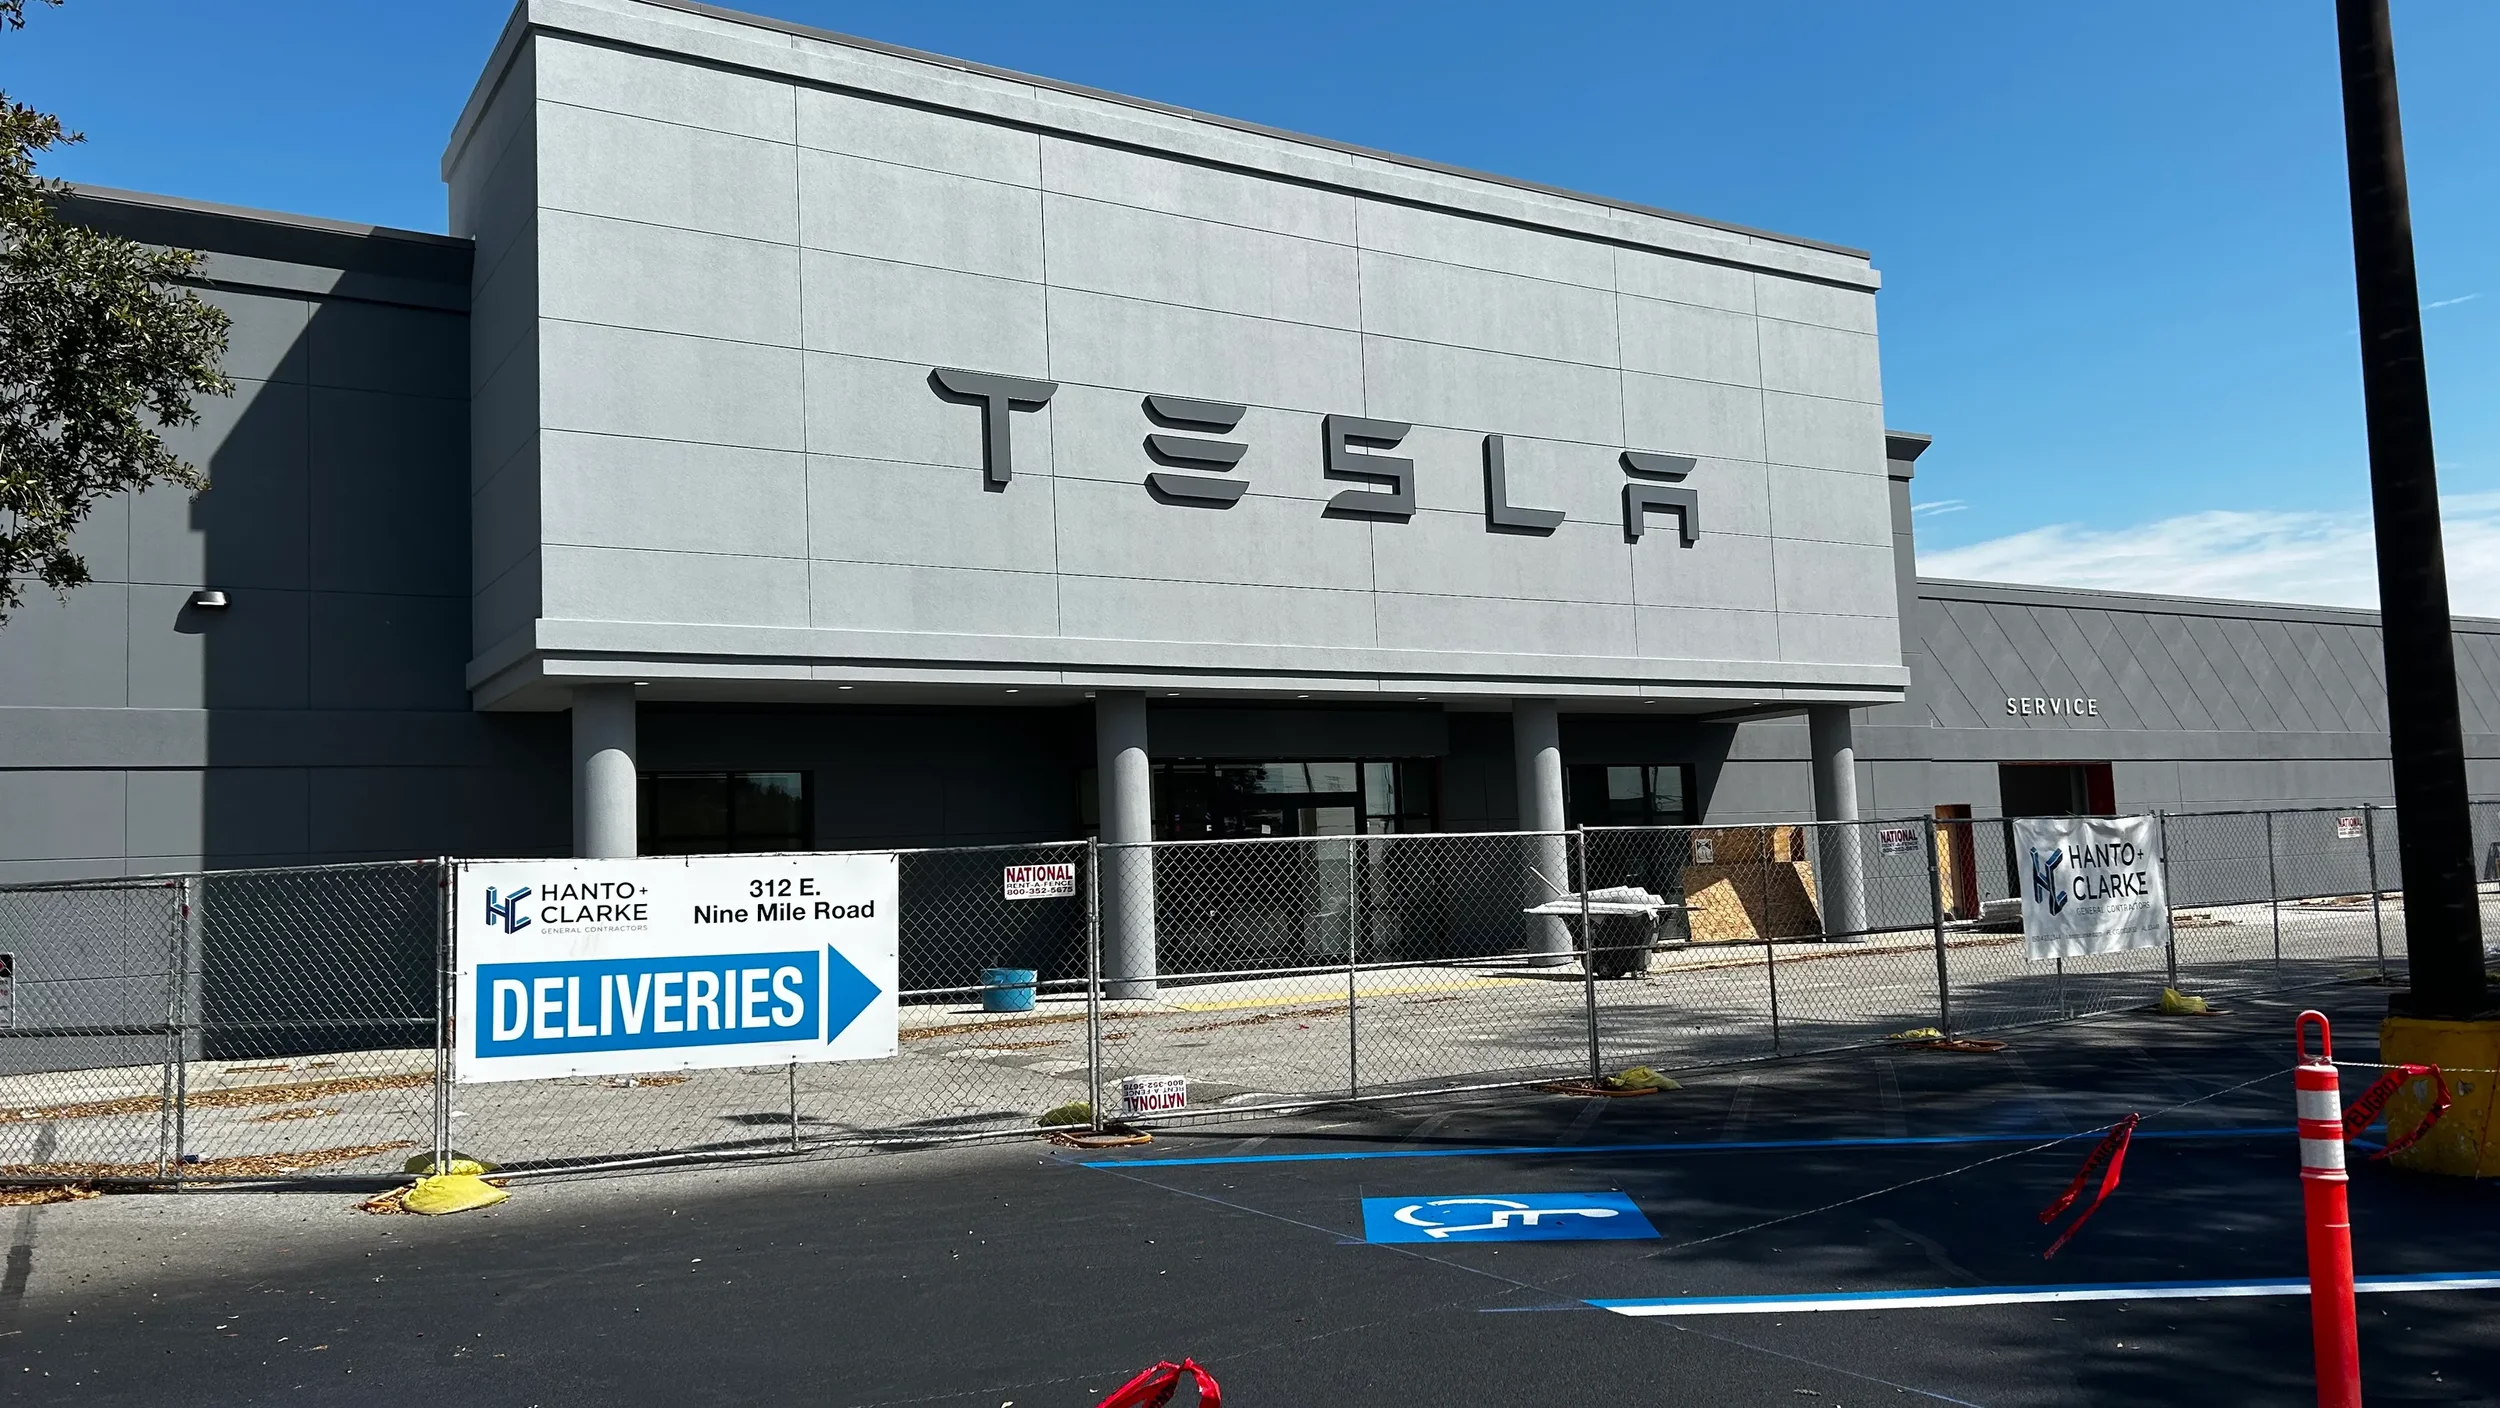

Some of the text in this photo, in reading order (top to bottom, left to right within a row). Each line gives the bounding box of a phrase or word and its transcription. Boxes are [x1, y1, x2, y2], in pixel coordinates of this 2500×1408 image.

[927, 367, 1699, 548] TESLA
[2006, 698, 2098, 716] SERVICE
[1880, 829, 1918, 843] NATIONAL
[1006, 865, 1073, 883] NATIONAL
[749, 877, 820, 898] 312 E.
[1006, 880, 1073, 889] RENT-A-FENCE
[2073, 871, 2148, 900] CLARKE
[541, 903, 648, 924] CLARKE
[694, 899, 874, 924] Nine Mile Road
[2076, 905, 2105, 916] GENERAL
[541, 924, 648, 935] GENERAL CONTRACTORS
[492, 966, 805, 1041] DELIVERIES
[1124, 1092, 1184, 1112] NATIONAL
